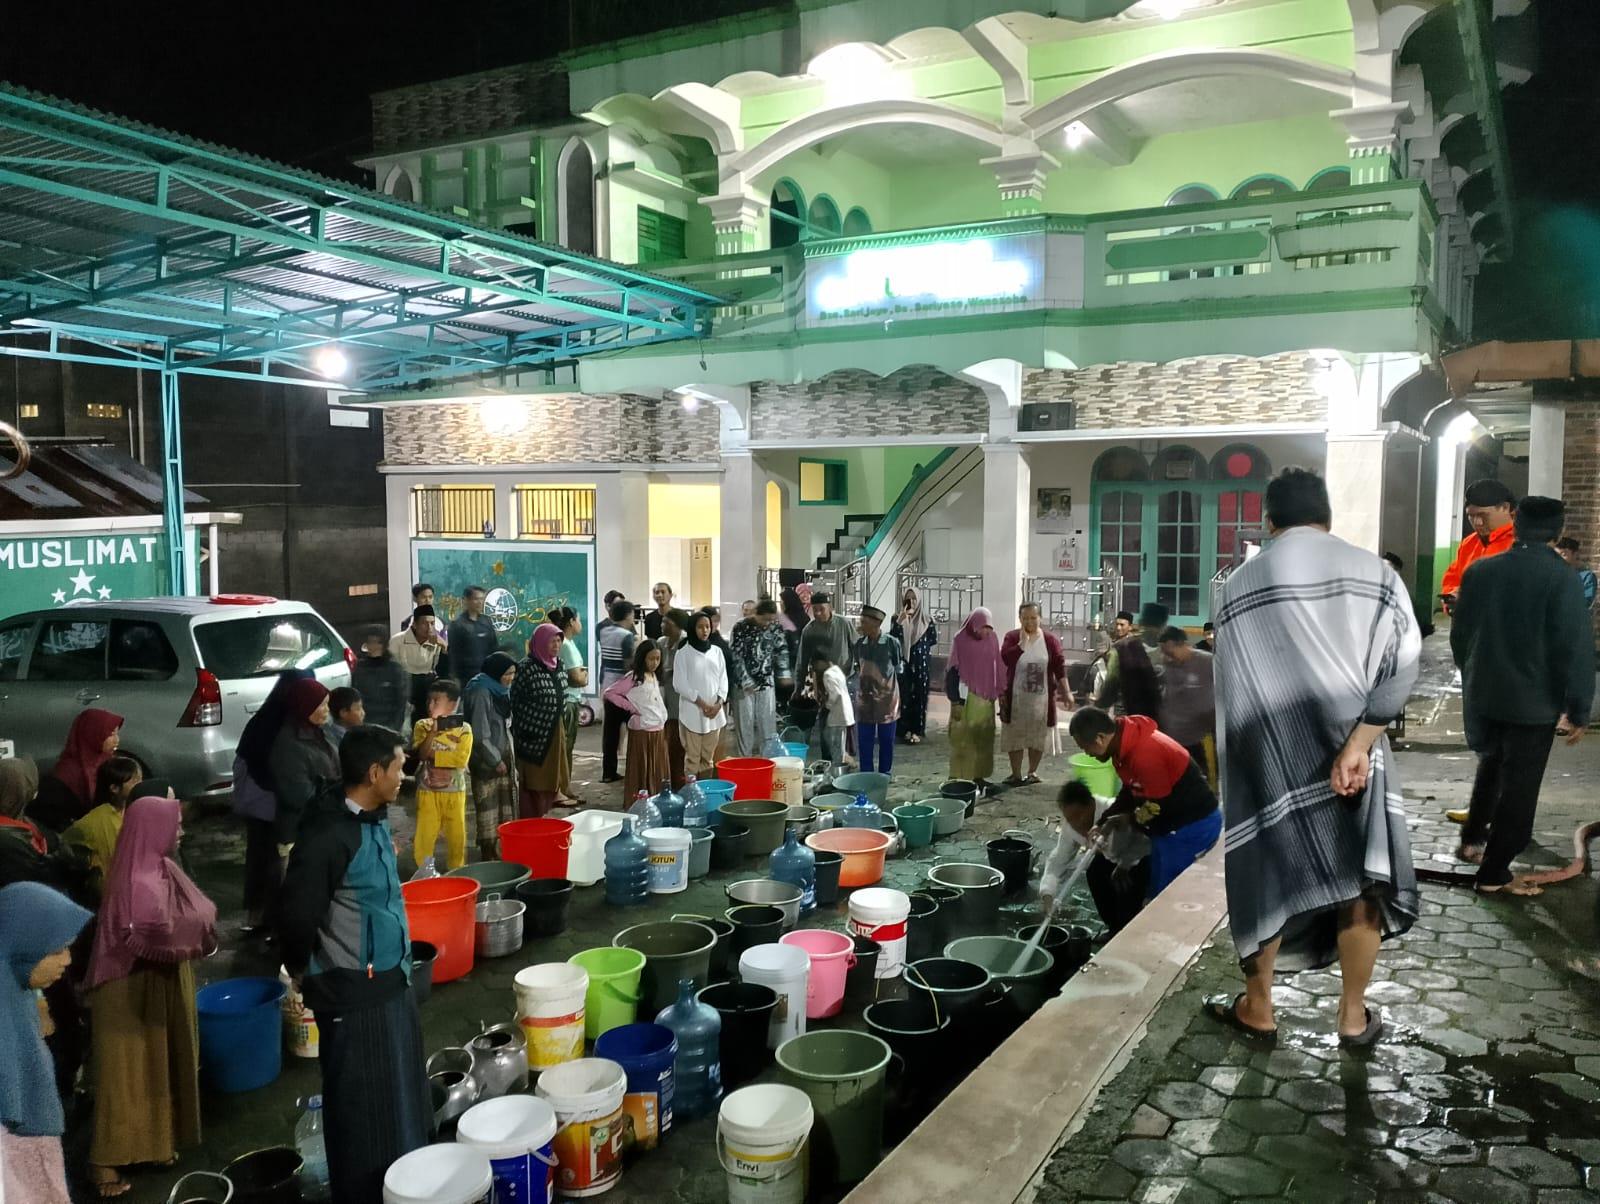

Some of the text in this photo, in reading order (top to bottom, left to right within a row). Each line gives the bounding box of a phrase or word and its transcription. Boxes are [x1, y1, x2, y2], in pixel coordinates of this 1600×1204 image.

[0, 537, 157, 570] MUSLIMAT
[1058, 559, 1074, 569] AMAL
[650, 855, 675, 864] JOTUN
